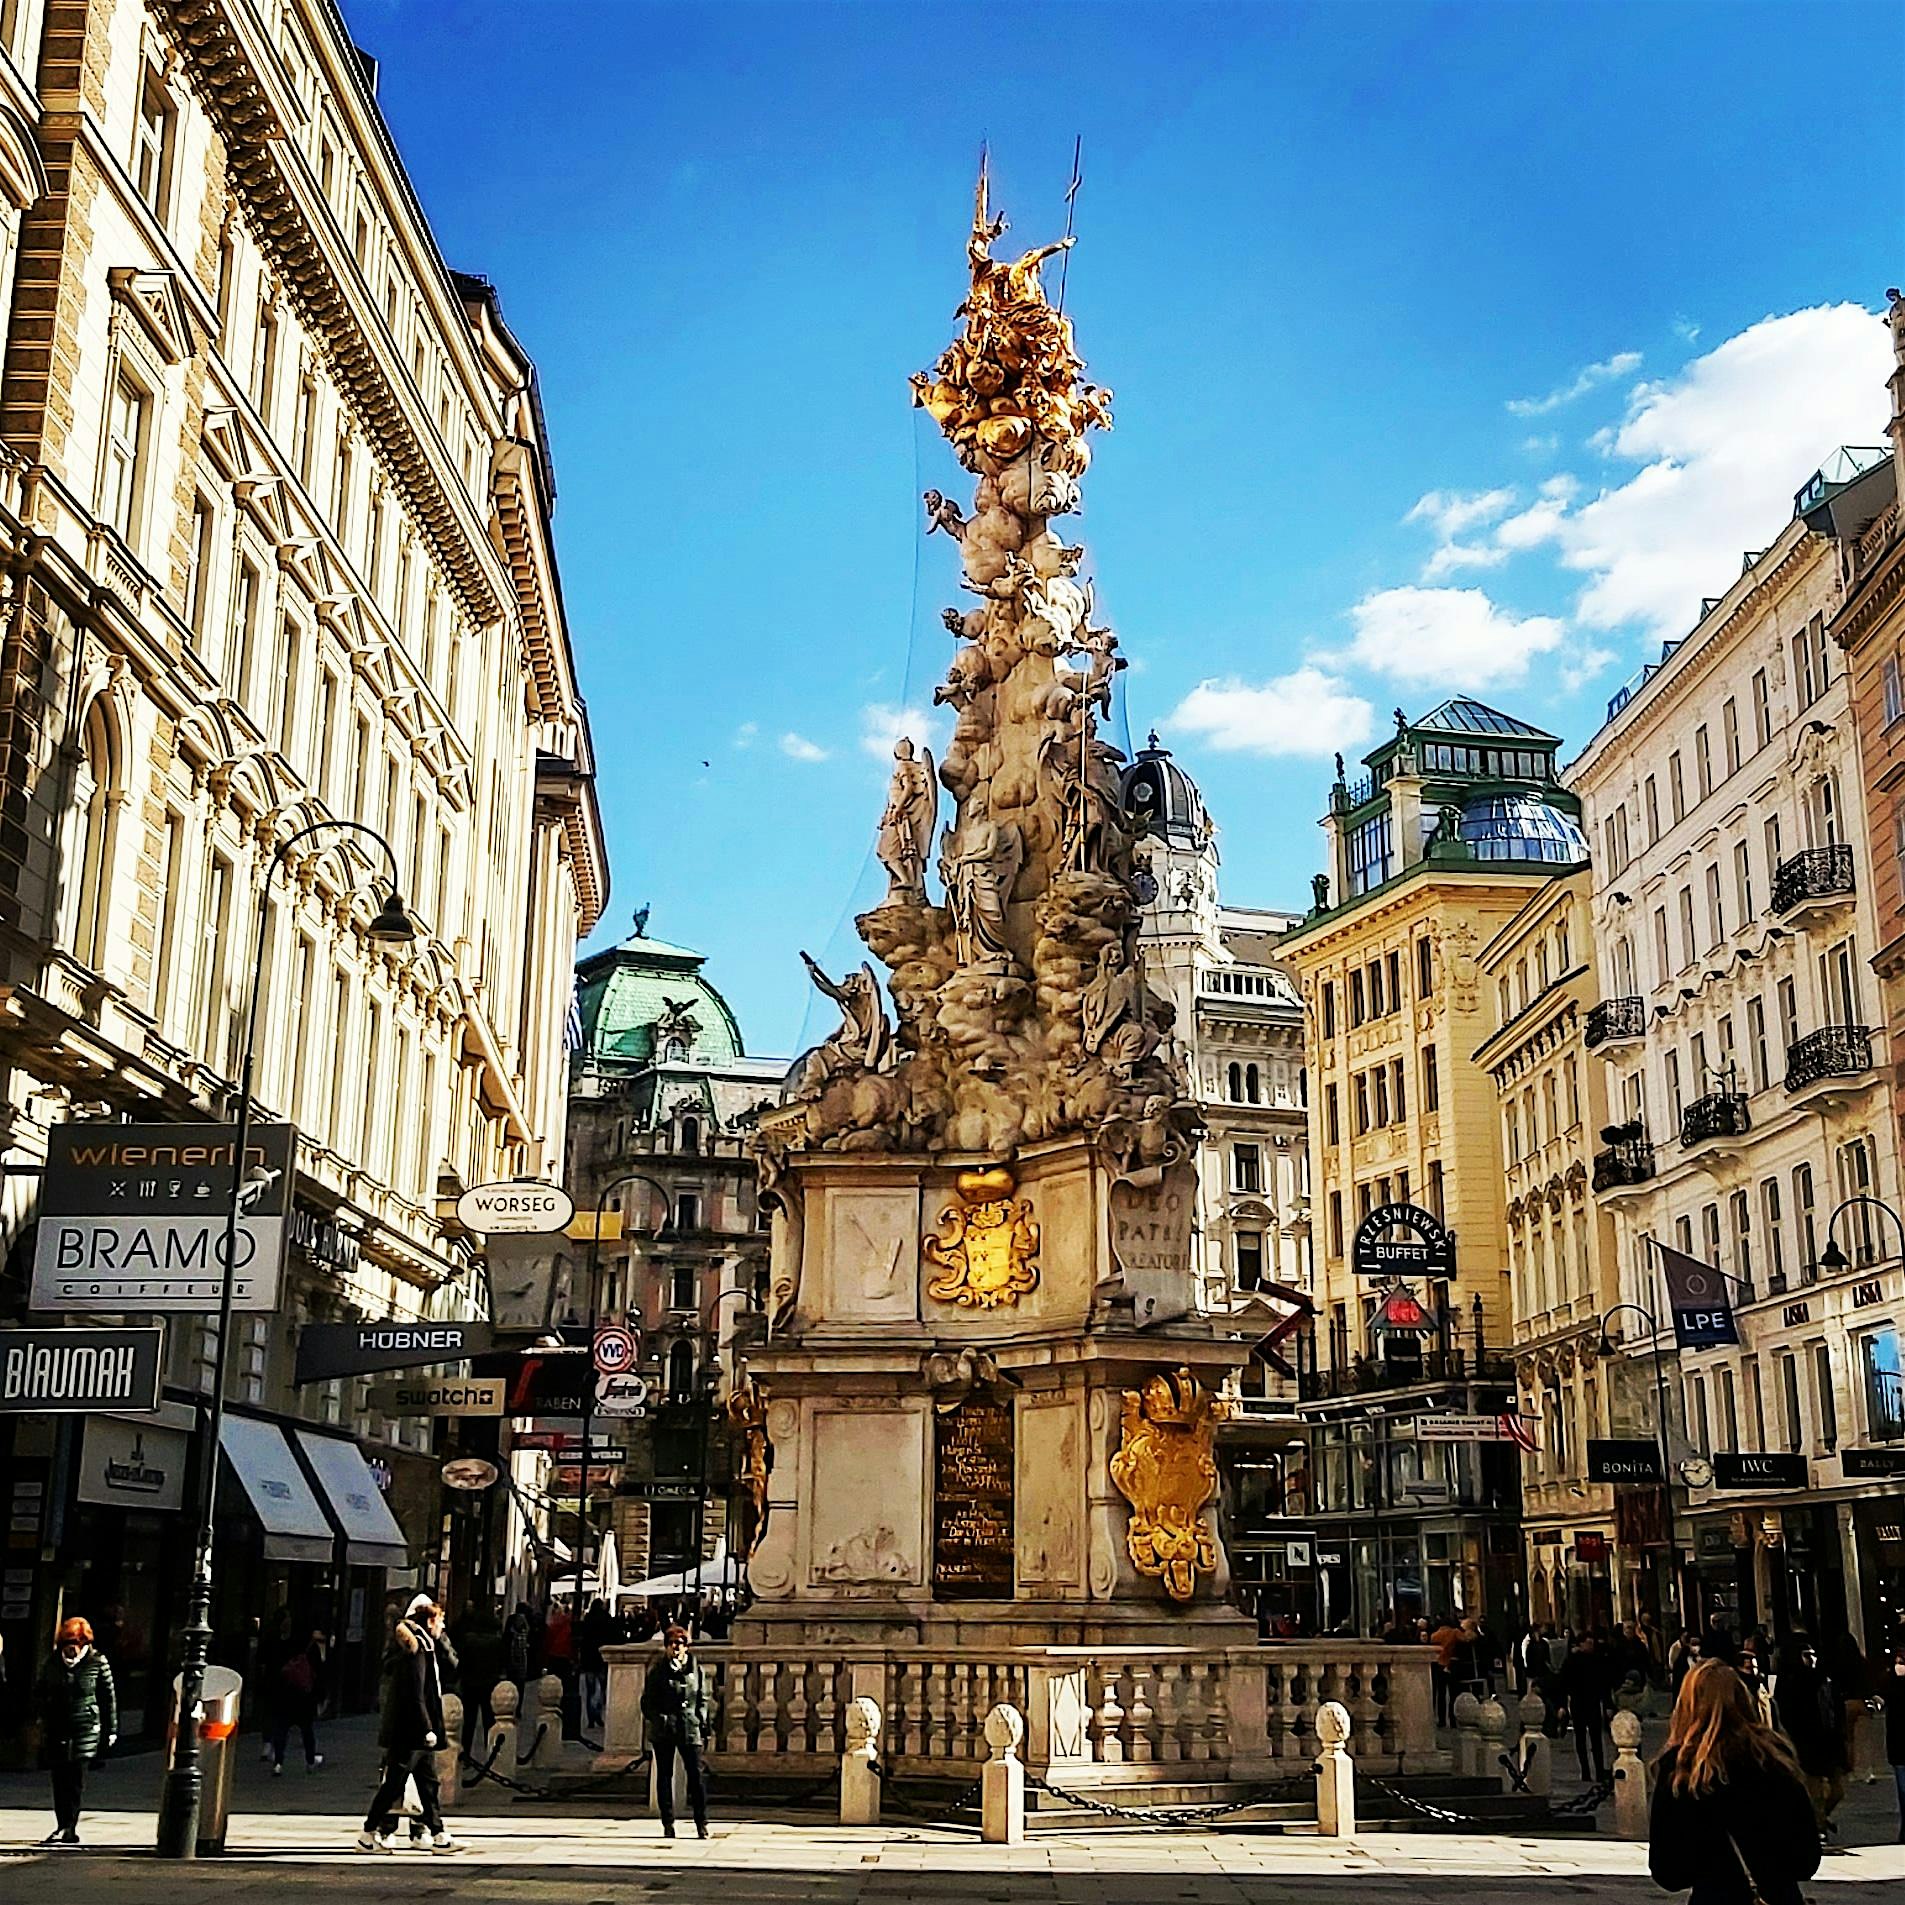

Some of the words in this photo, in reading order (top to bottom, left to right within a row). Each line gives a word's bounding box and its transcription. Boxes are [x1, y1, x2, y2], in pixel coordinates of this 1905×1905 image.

[71, 1143, 266, 1166] wienerin
[475, 1197, 555, 1212] WORSEG
[57, 1228, 256, 1269] BRAMO
[1376, 1246, 1429, 1260] BUFFET
[62, 1284, 246, 1295] COIFFEUR
[1681, 1311, 1726, 1333] LPE
[359, 1330, 462, 1350] HÜBNER
[396, 1386, 477, 1406] swatch
[1742, 1459, 1775, 1473] IWC
